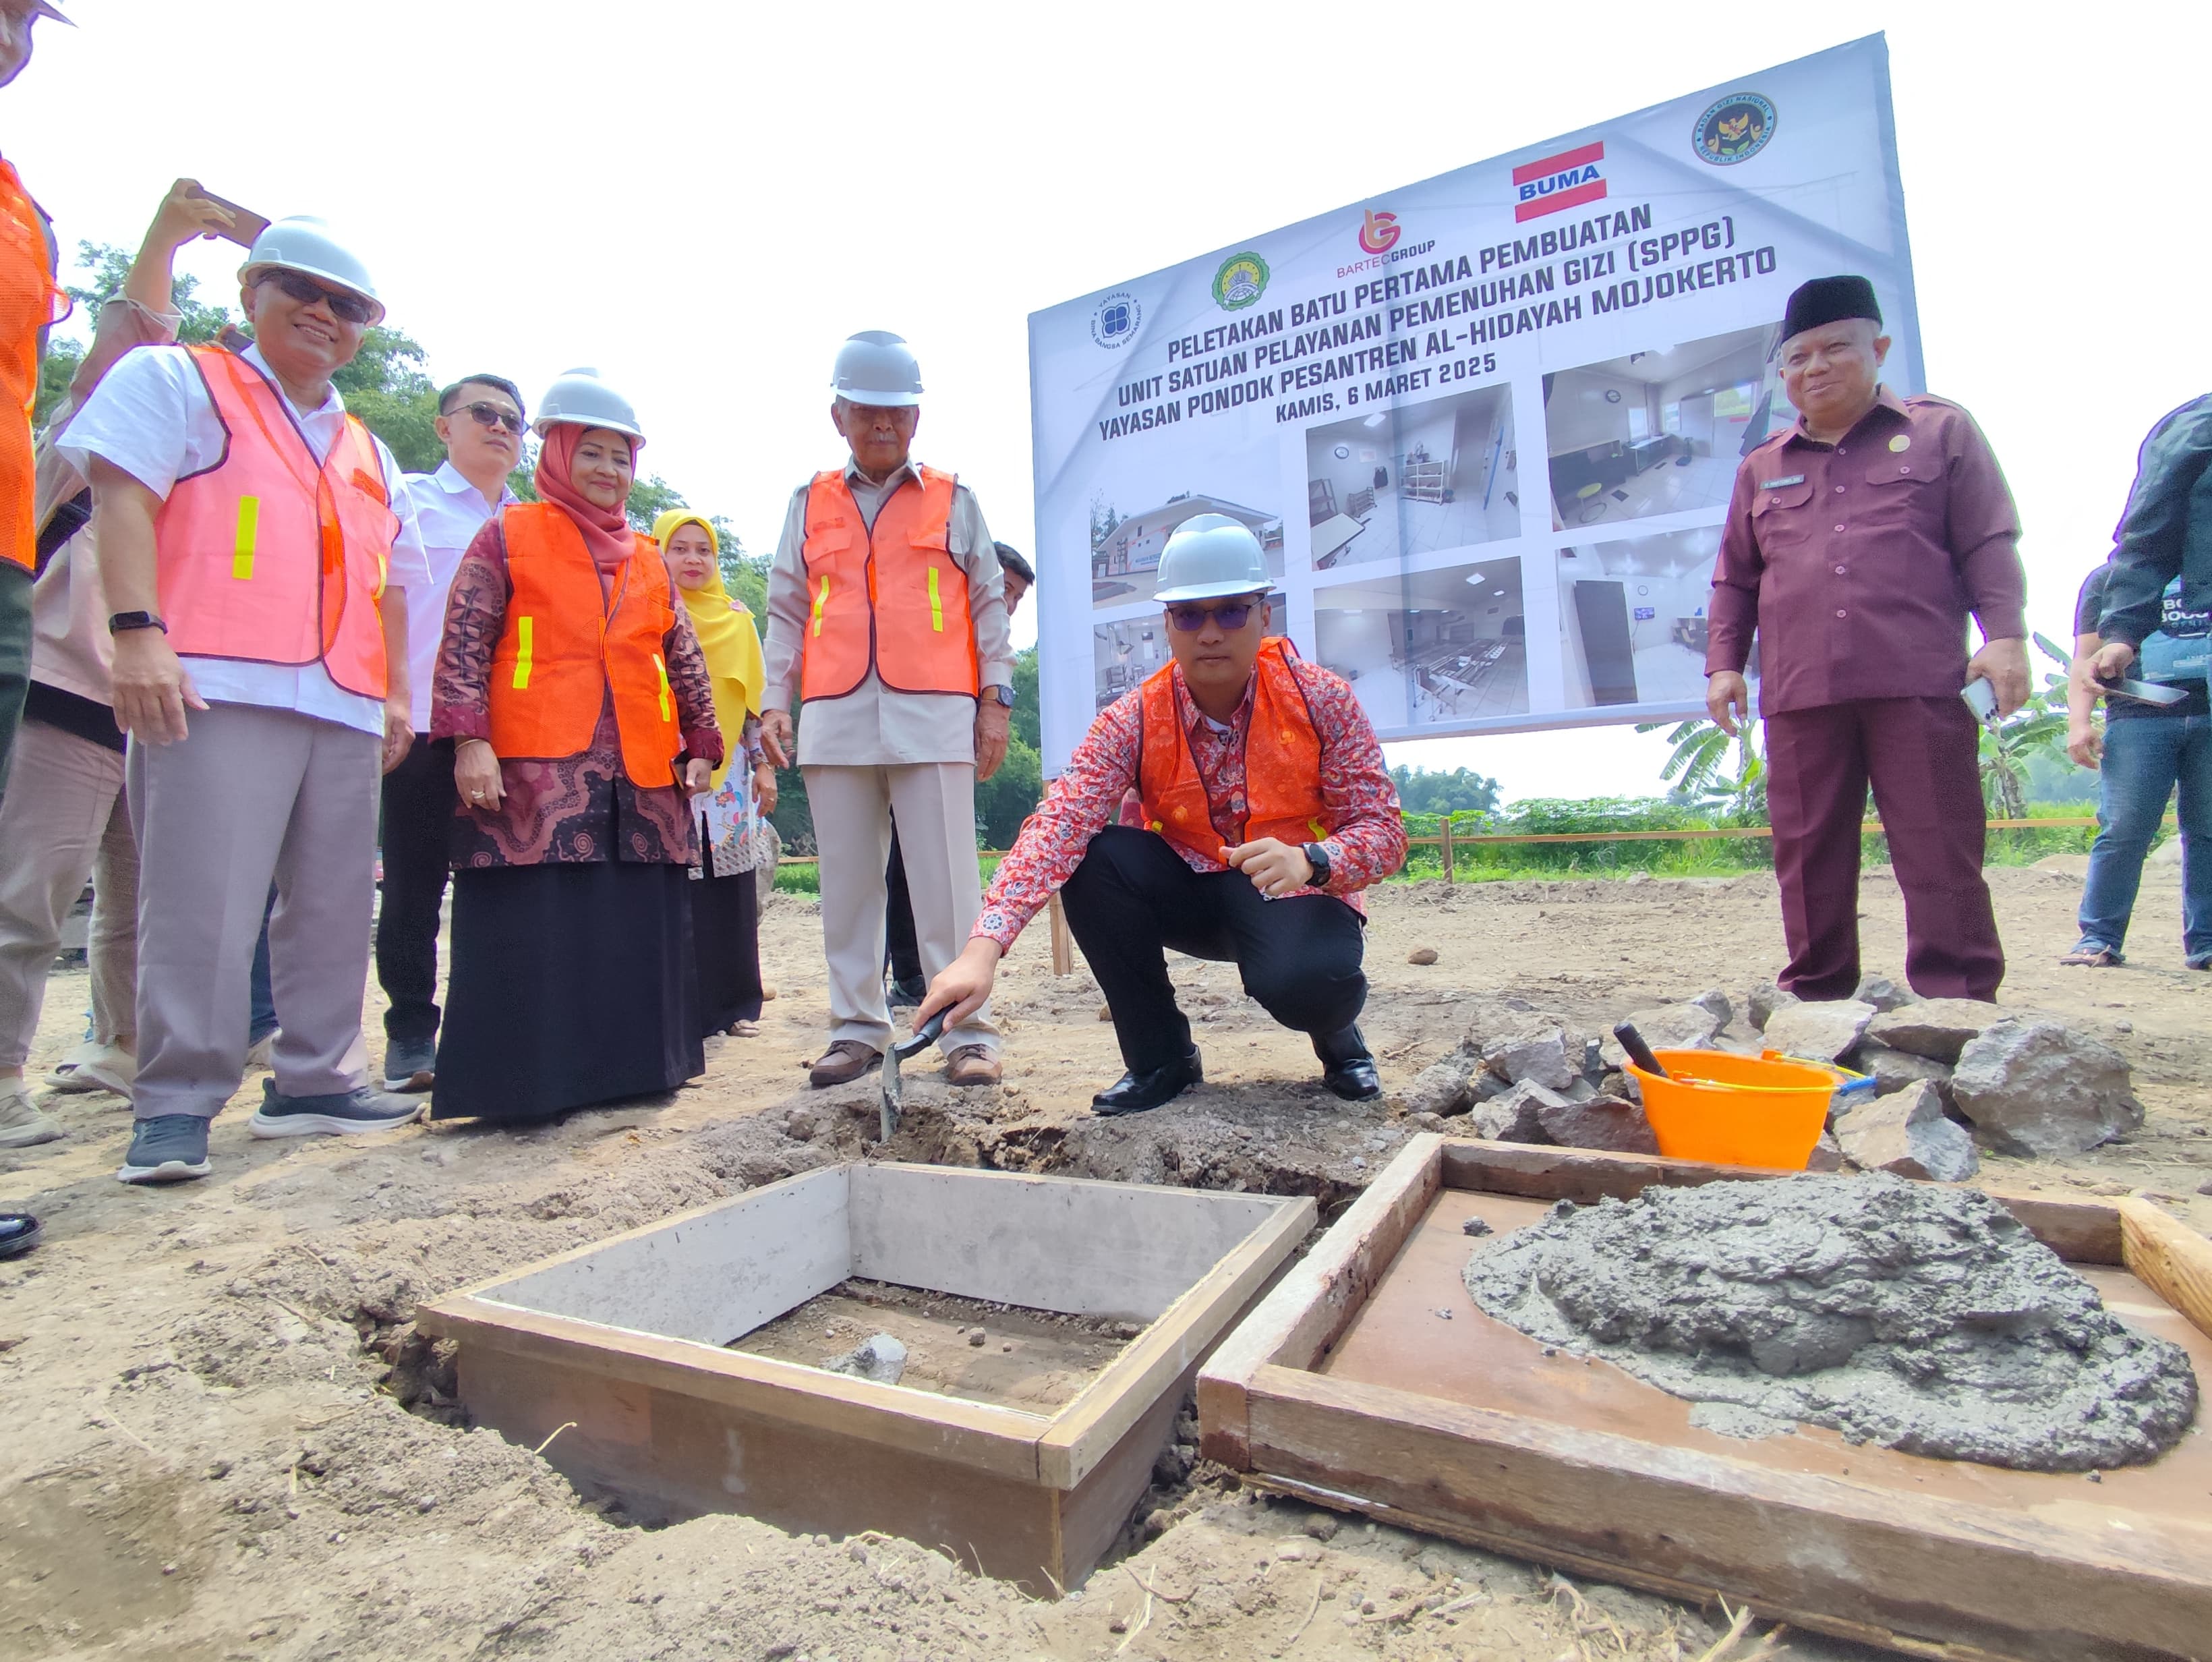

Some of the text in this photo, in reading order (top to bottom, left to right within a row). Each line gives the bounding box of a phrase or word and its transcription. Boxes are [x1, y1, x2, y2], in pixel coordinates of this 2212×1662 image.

[1737, 96, 1770, 112] NASIONAL
[1699, 126, 1771, 162] REPUBLIK INDONESIA
[1519, 165, 1600, 201] BUMA
[1099, 292, 1131, 308] YAYASAN
[1168, 309, 1283, 363] PELETAKAN
[1291, 290, 1347, 327] BATU
[1356, 254, 1473, 306] PERTAMA
[1480, 203, 1652, 273] PEMBUATAN
[1095, 337, 1121, 349] BANGSA
[1122, 304, 1142, 345] SEMARANG
[1118, 216, 1734, 407] UNIT SATUAN PELAYANAN PEMENUHAN GIZI (SPPG)
[1099, 246, 1776, 441] YAYASAN PONDOK PESANTREN AL-HIDAYAH MOJOKERTO
[1275, 352, 1496, 424] KAMIS, 6 MARET 2025
